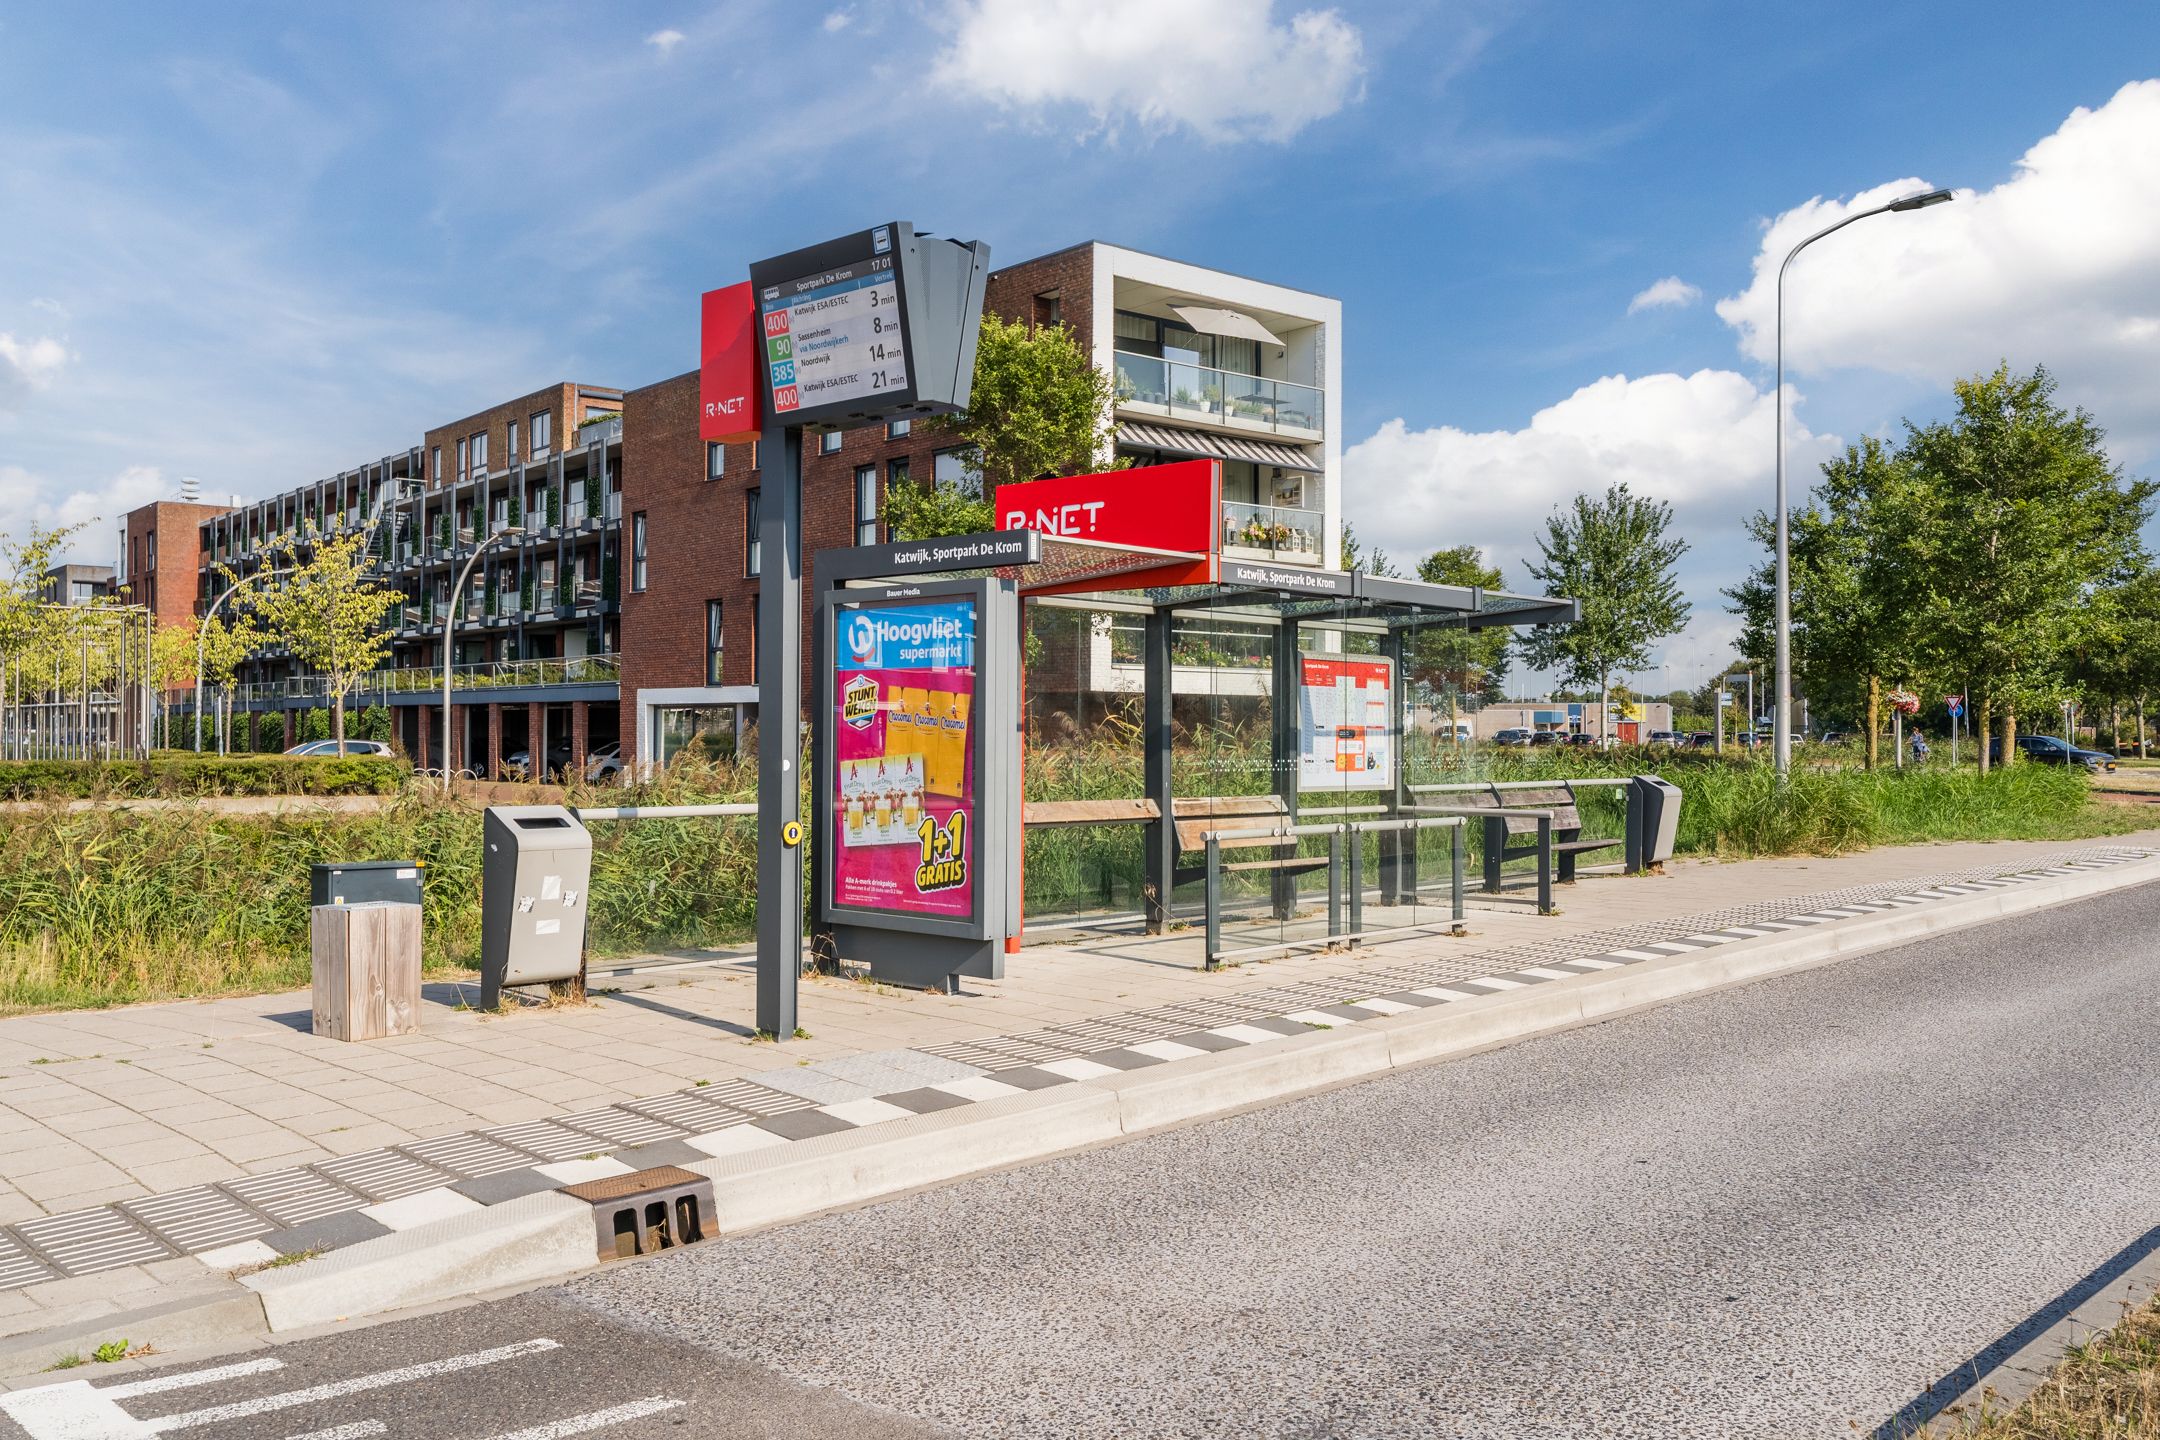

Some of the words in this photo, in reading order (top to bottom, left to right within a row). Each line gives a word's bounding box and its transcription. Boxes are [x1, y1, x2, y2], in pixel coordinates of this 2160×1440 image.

[796, 276, 826, 292] Sportpark
[826, 274, 835, 283] De
[835, 270, 853, 280] Krom
[767, 313, 788, 331] 400
[794, 304, 816, 316] Katwijk
[817, 295, 849, 311] ESA/ESTEC
[870, 290, 879, 307] 3
[881, 294, 895, 305] min
[776, 338, 791, 355] 90
[797, 327, 831, 342] Sassenheim
[873, 316, 882, 334] 8
[884, 321, 899, 333] min
[799, 345, 808, 353] via
[773, 363, 794, 382] 385
[801, 353, 831, 367] Noordwijk
[869, 343, 885, 362] 14
[887, 348, 902, 359] min
[777, 389, 797, 407] 400
[803, 381, 827, 393] Katwijk
[827, 373, 859, 388] ESA/ESTEC
[872, 370, 887, 389] 21
[890, 375, 905, 386] min
[894, 548, 931, 565] Katwijk,
[933, 543, 979, 563] Sportpark
[980, 543, 994, 556] De
[995, 541, 1022, 554] Krom
[1237, 567, 1268, 583] Katwijk,
[1269, 571, 1305, 587] Sportpark
[1305, 575, 1316, 587] De
[1316, 577, 1336, 589] Krom
[903, 587, 920, 596] Media
[877, 616, 963, 646] Hoogvliet
[899, 643, 963, 664] supermarkt
[847, 685, 876, 704] STUNT
[918, 811, 965, 863] 1+1
[916, 859, 963, 887] GRATIS
